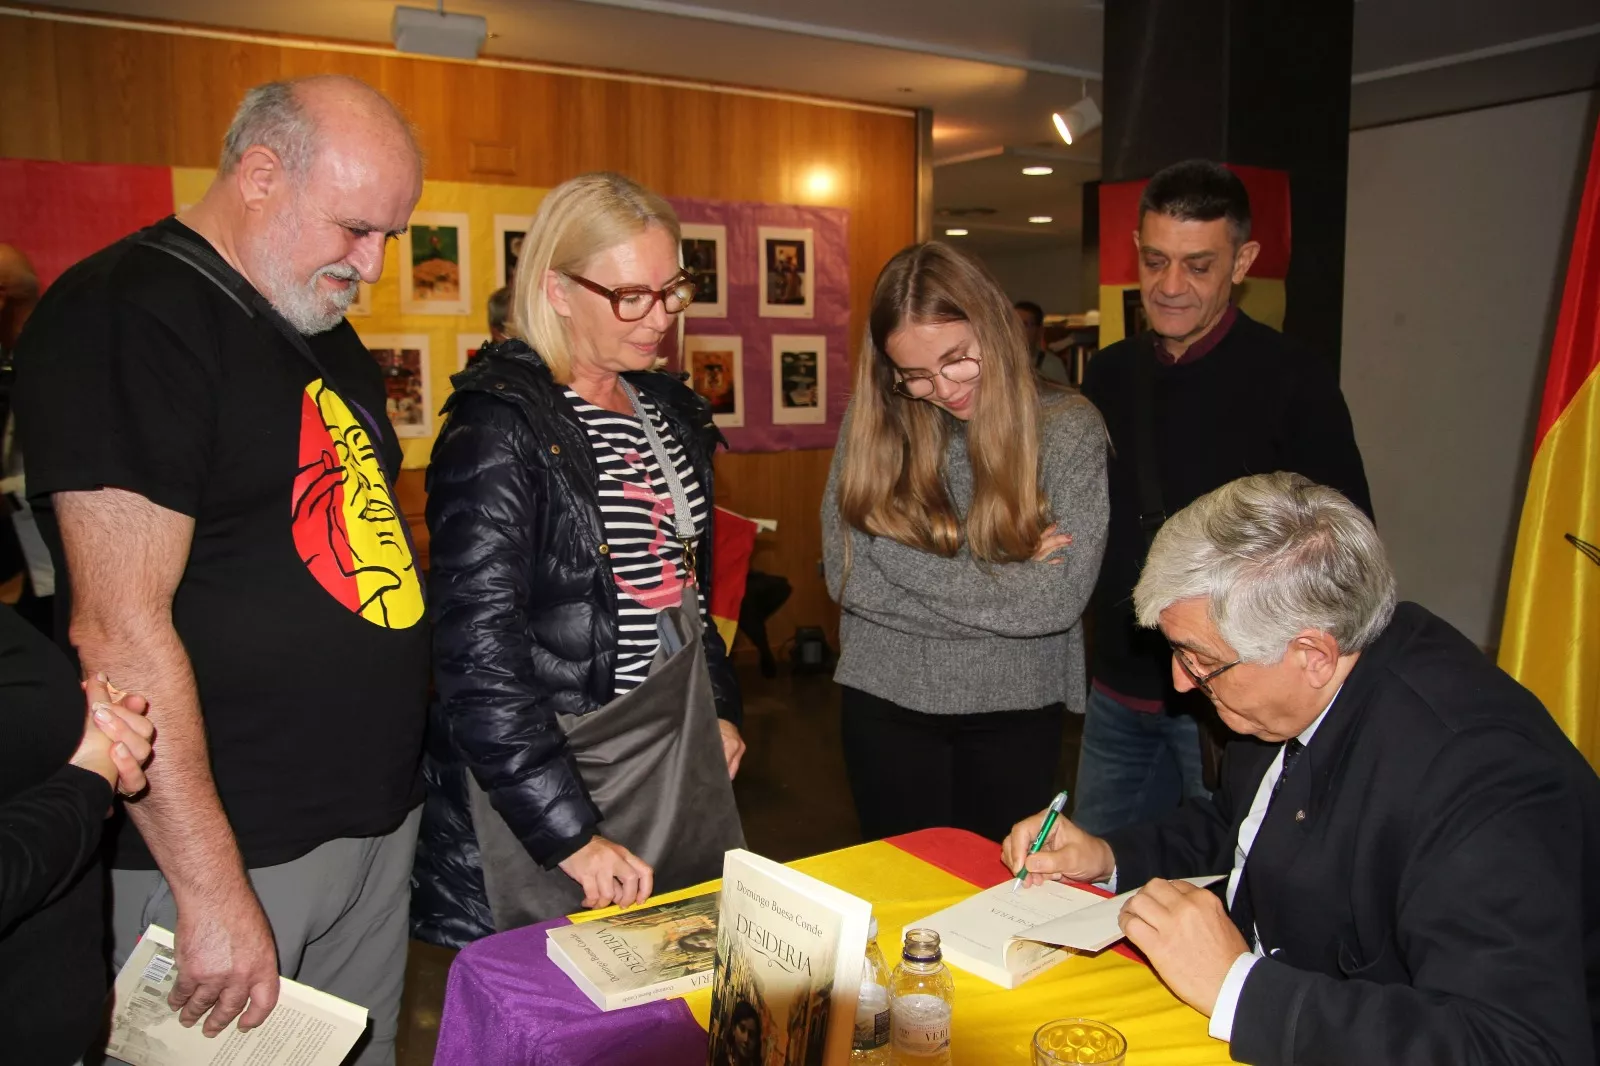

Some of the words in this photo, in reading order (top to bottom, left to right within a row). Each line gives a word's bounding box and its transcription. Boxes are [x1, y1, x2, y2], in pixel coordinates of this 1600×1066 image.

[736, 880, 770, 908] Domingo
[771, 900, 794, 922] Buesa
[795, 914, 823, 937] Conde
[596, 928, 647, 974] DESIDERIA
[736, 913, 812, 977] DESIDERIA
